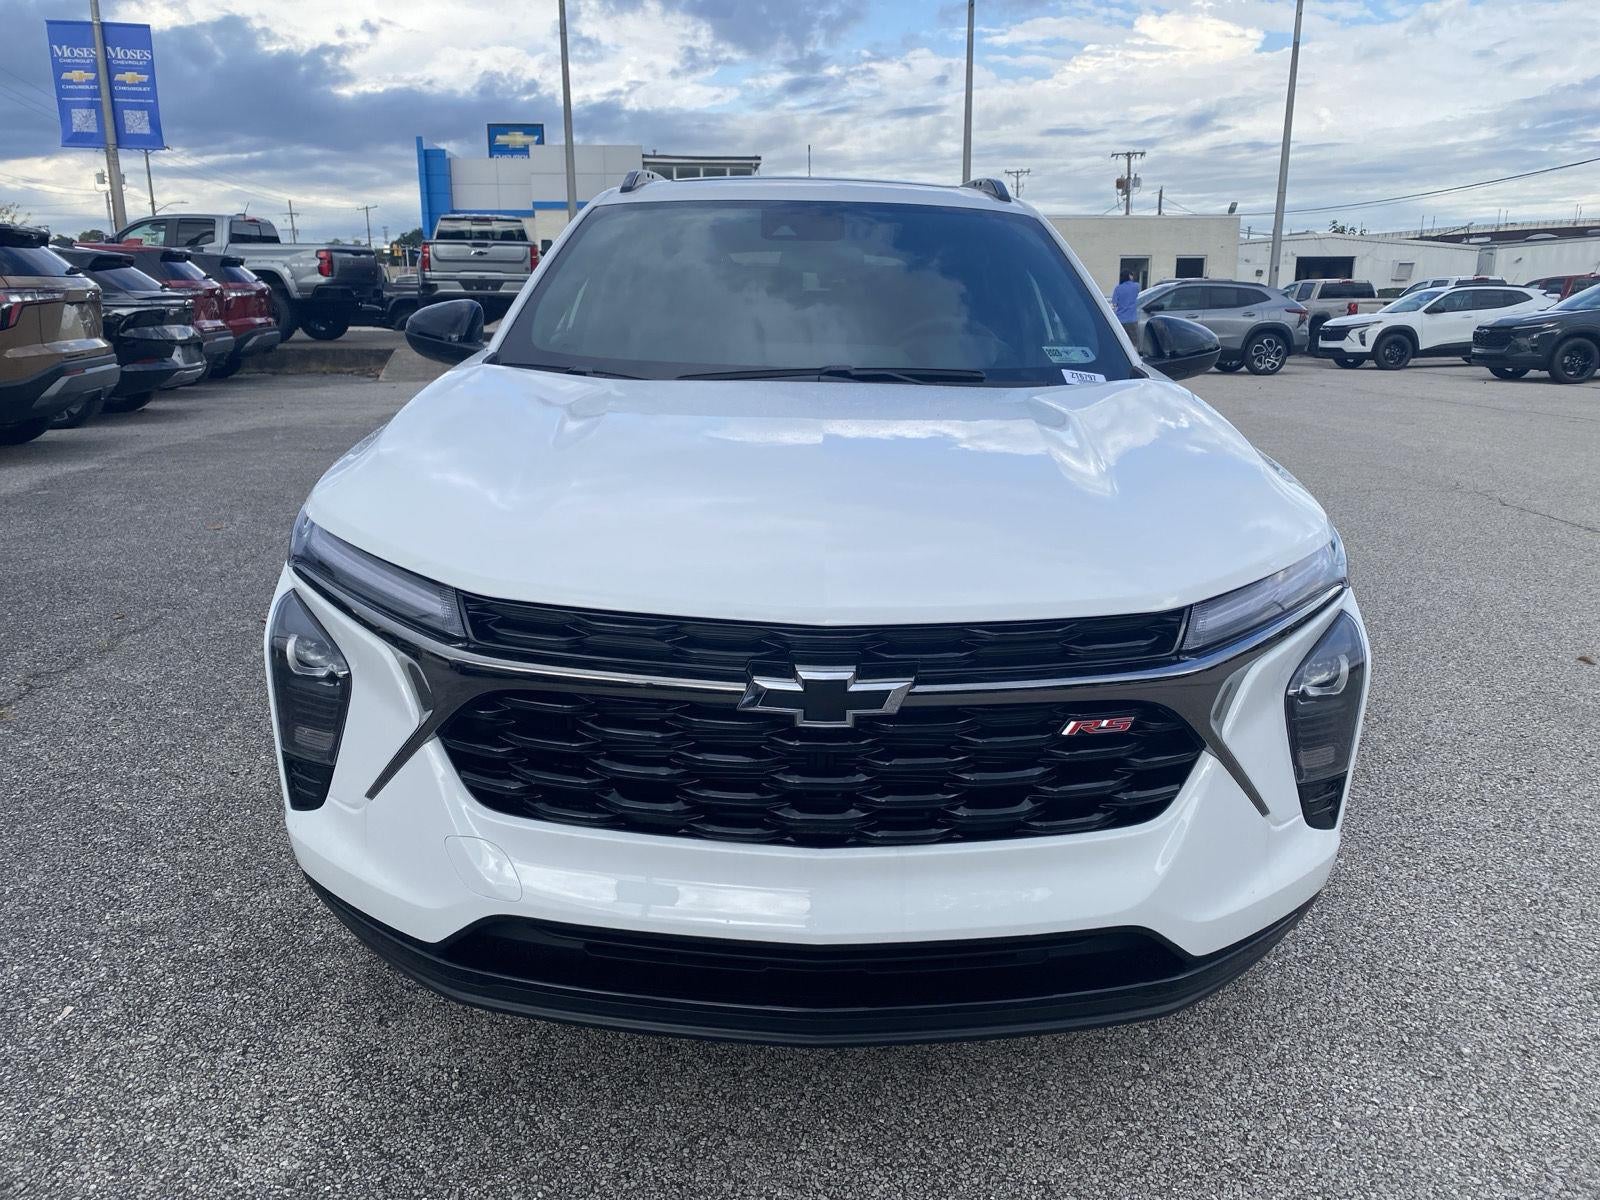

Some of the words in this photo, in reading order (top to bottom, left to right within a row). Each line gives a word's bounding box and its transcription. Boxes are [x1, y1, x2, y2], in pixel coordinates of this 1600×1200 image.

[53, 45, 97, 58] MOSES
[107, 46, 152, 60] MOSES
[1061, 717, 1135, 735] RS
